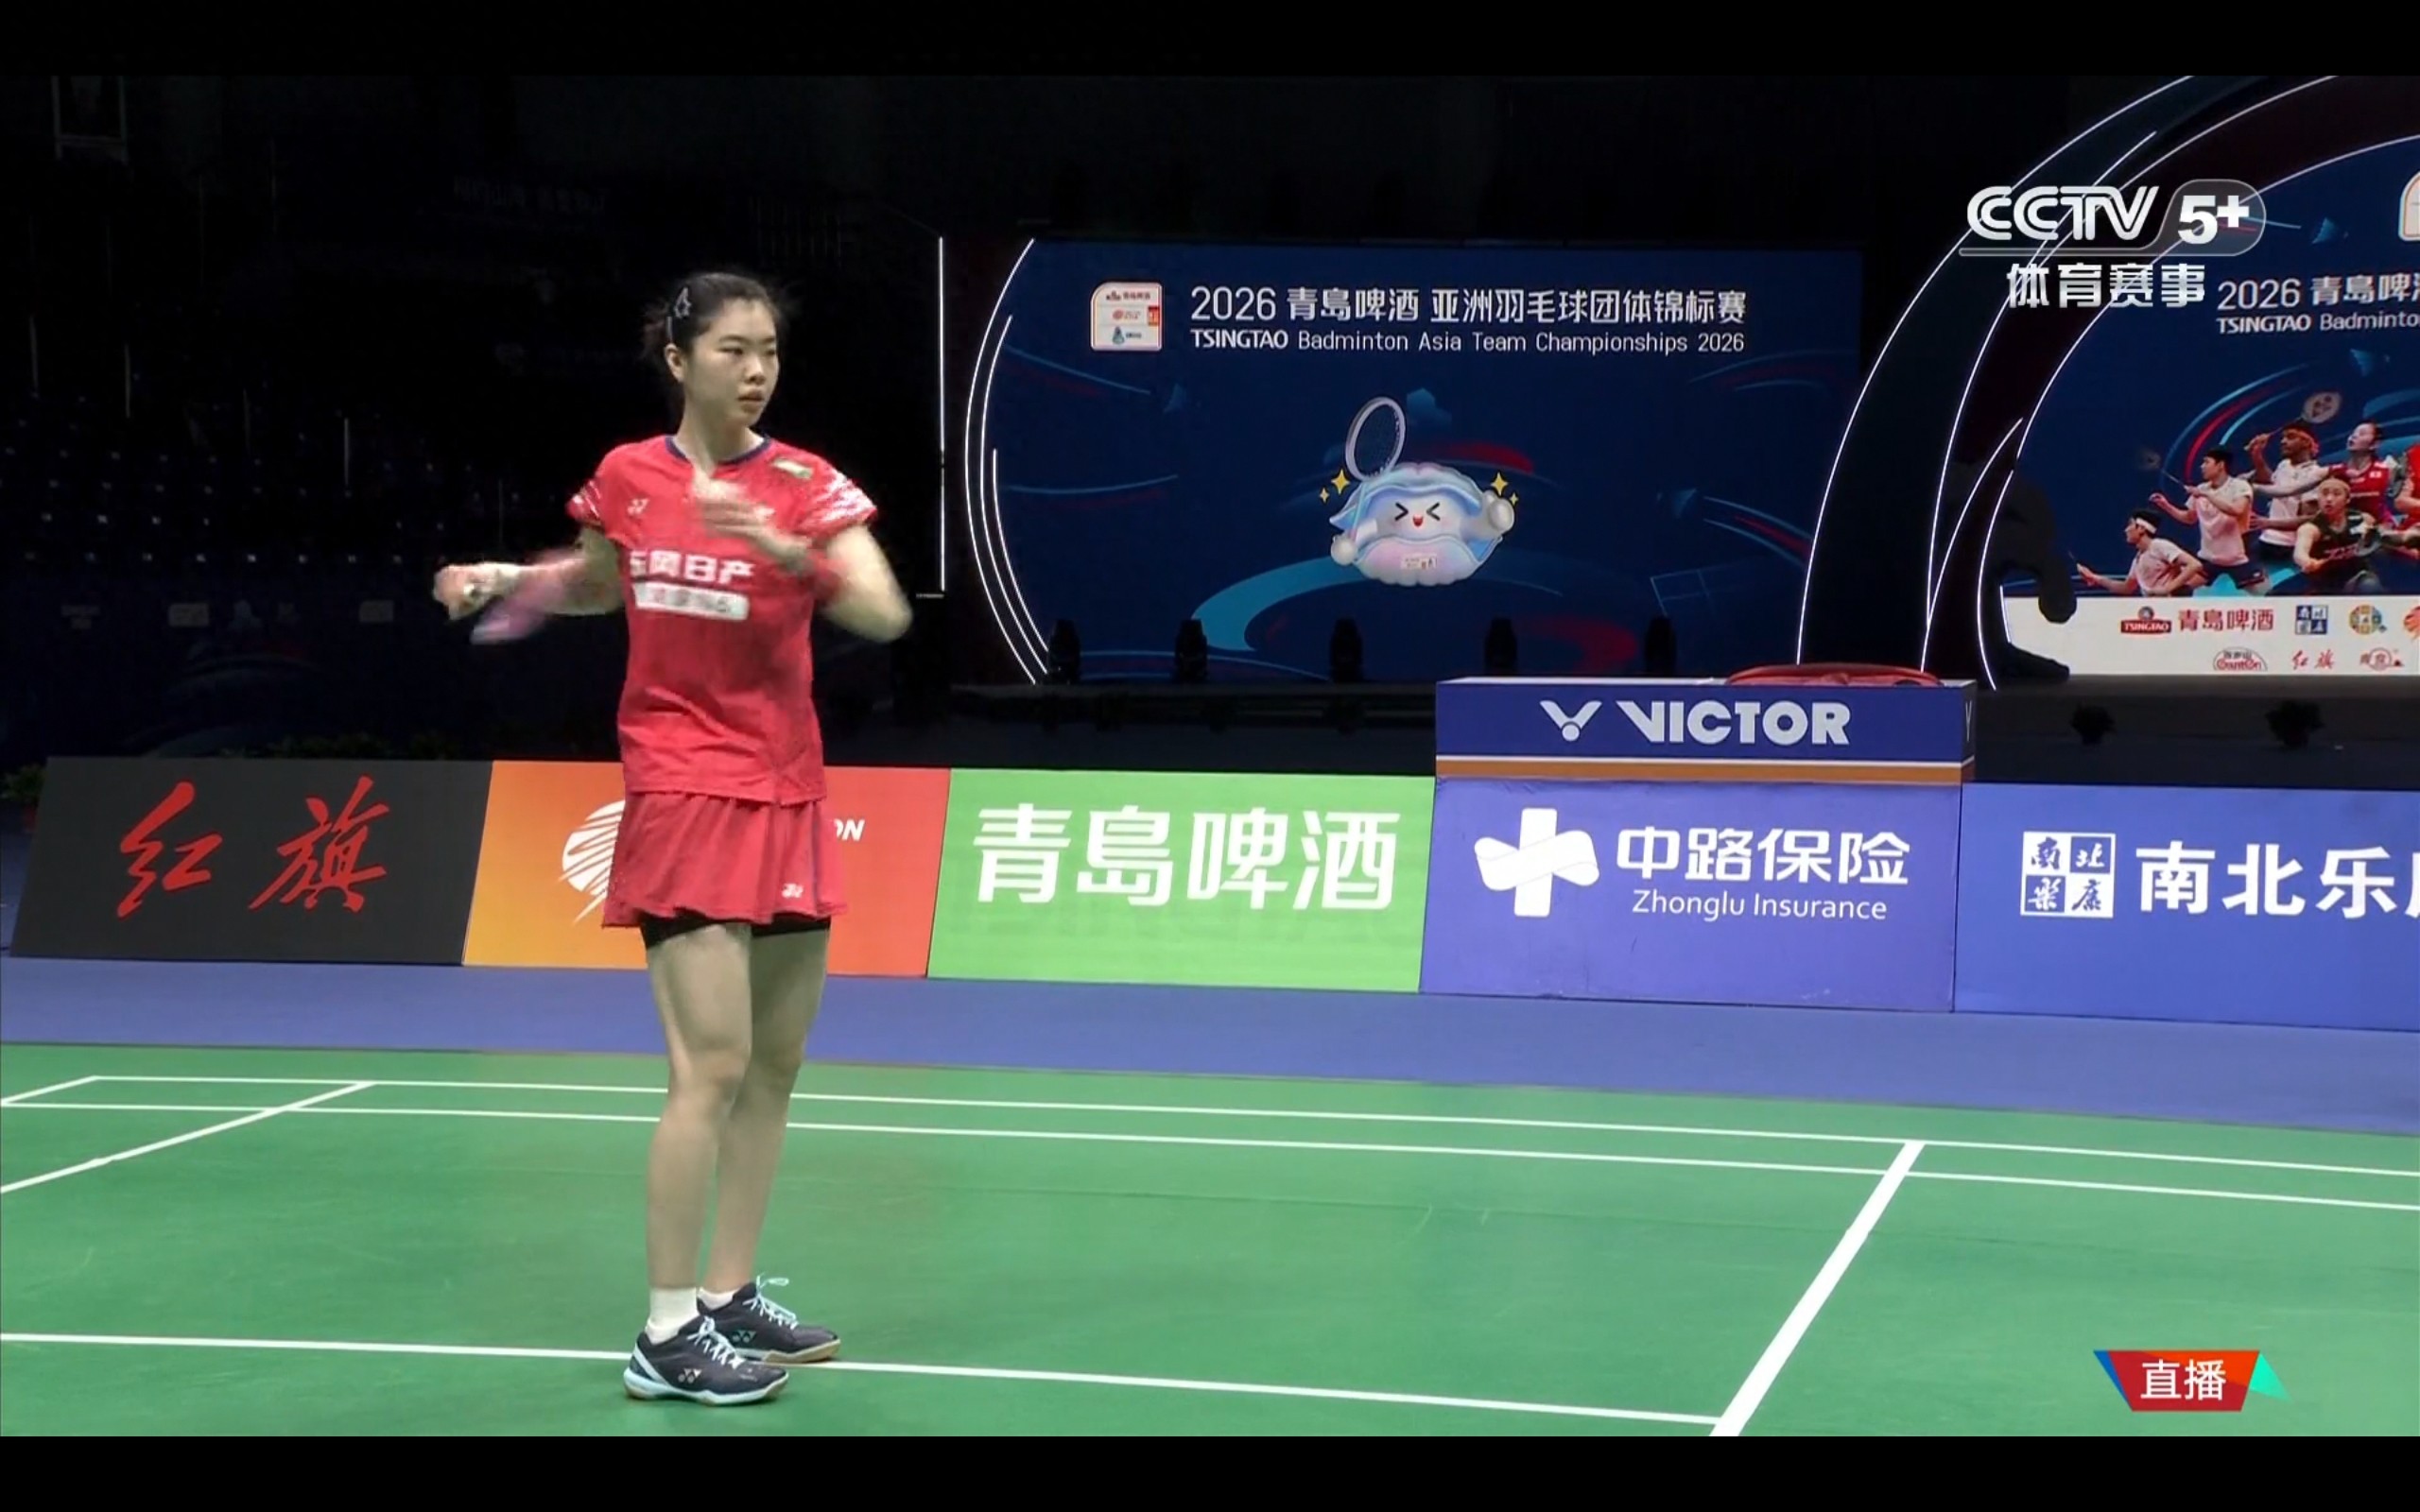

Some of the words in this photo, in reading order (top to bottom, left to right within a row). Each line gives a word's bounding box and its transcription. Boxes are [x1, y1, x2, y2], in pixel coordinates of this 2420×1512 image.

[1191, 286, 1276, 321] 2026
[1430, 289, 1746, 323] 亚洲羽毛球团体锦标赛
[2217, 278, 2302, 311] 2026
[1190, 329, 1288, 349] TSINGTAO
[1299, 330, 1409, 351] Badminton
[1418, 331, 1461, 351] Asia
[1473, 332, 1526, 352] Team
[1536, 332, 1687, 355] Championships
[1698, 333, 1744, 352] 2026
[2216, 313, 2311, 335] TSINGTAO
[1616, 700, 1850, 745] VICTOR
[115, 775, 389, 919] 红旗
[1616, 826, 1910, 885] 中路保险
[2135, 840, 2420, 919] 南北乐
[1633, 889, 1745, 922] Zhonglu
[1754, 892, 1887, 920] Insurance
